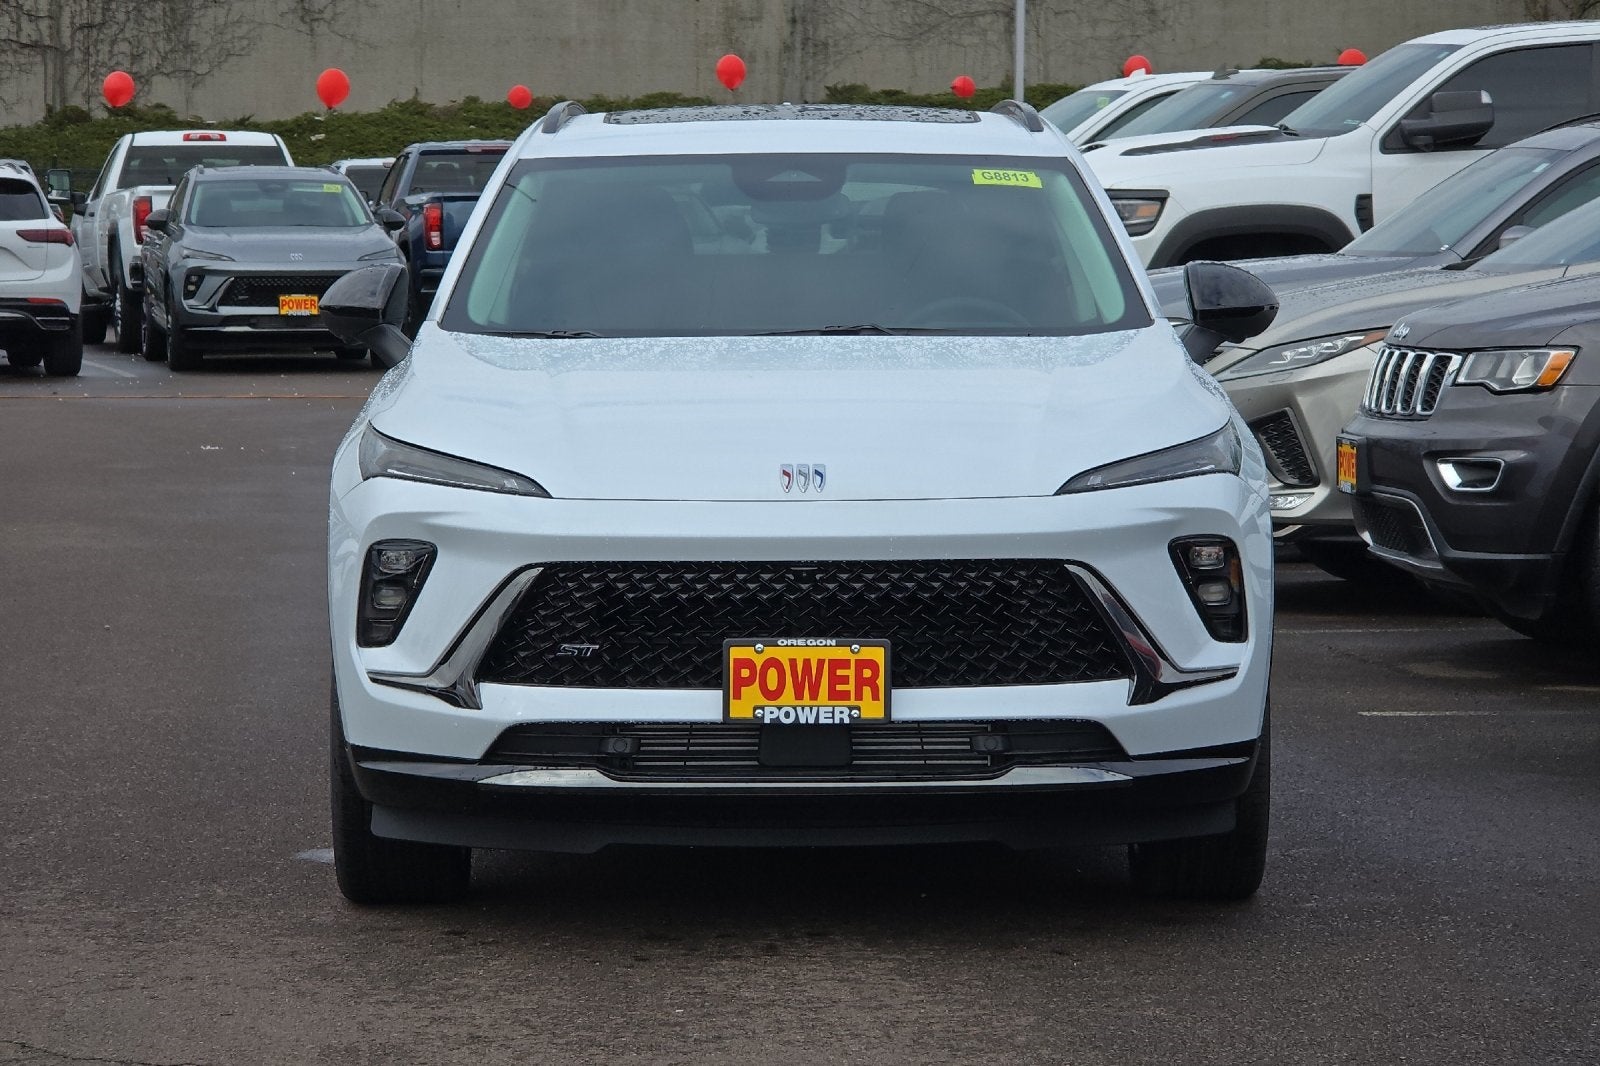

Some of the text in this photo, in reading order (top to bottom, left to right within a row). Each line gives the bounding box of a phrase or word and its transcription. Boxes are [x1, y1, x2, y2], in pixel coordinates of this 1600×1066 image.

[981, 171, 1029, 182] G8813
[281, 299, 317, 310] POWER
[556, 643, 599, 657] ST
[732, 656, 881, 702] POWER
[763, 706, 850, 724] POWER
